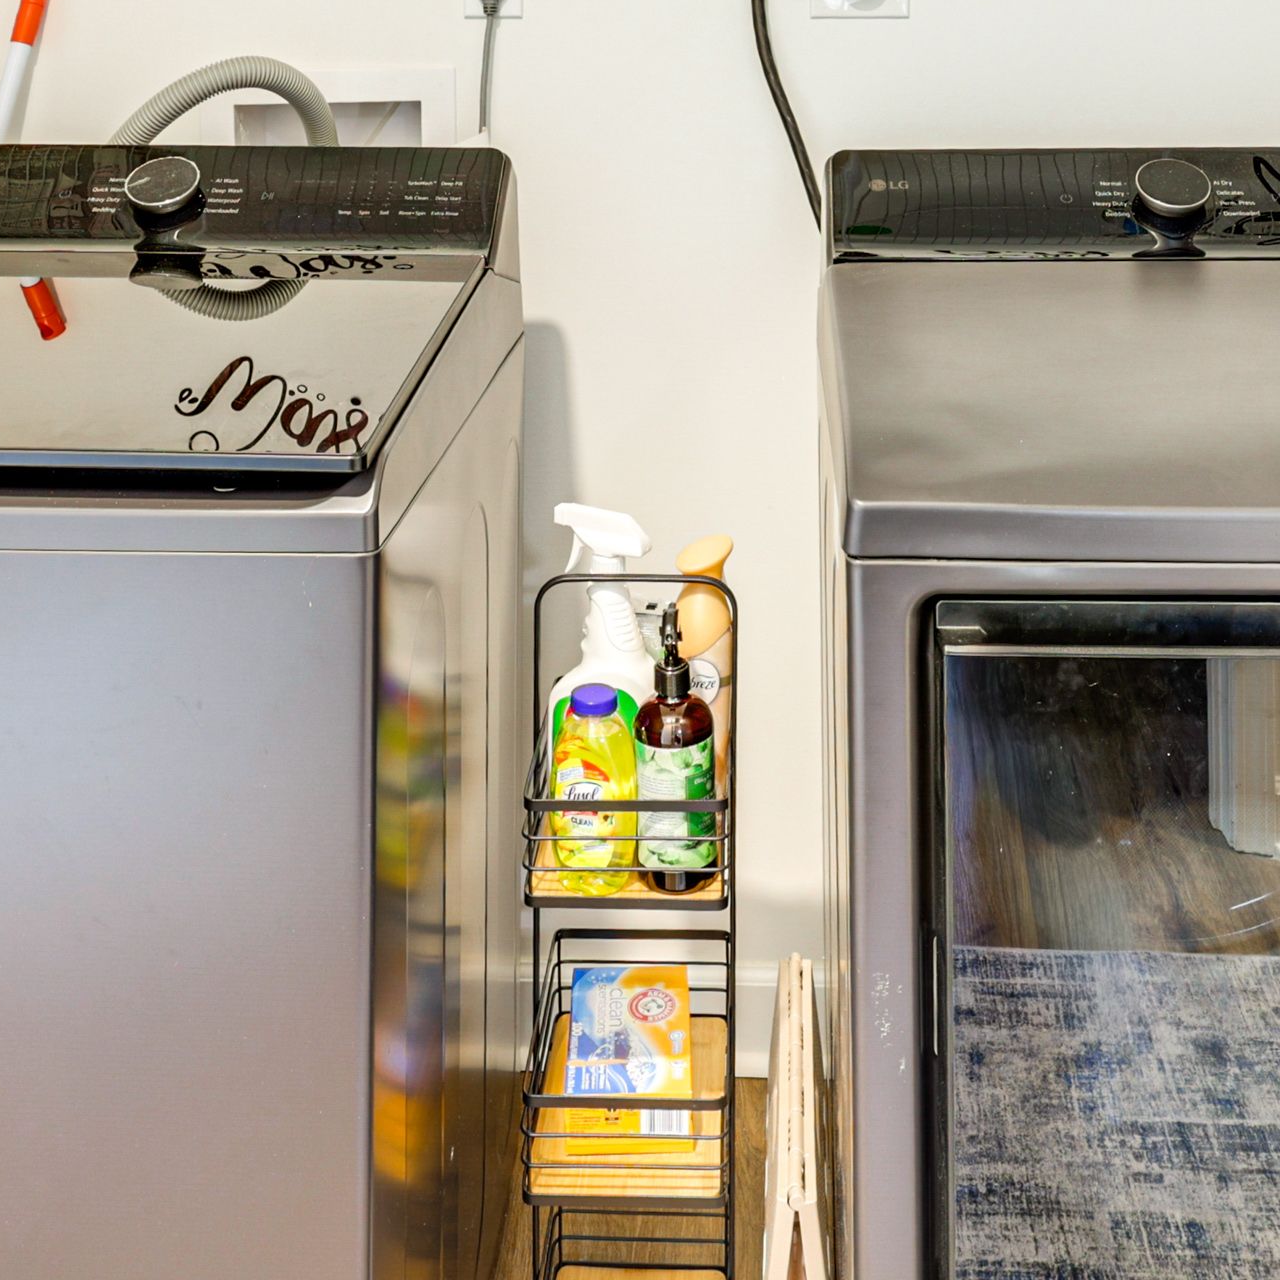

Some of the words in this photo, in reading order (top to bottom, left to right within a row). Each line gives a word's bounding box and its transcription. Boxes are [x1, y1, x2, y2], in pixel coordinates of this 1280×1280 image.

[1112, 200, 1127, 208] Duty
[571, 816, 594, 827] CLEAN
[609, 987, 627, 1028] clean
